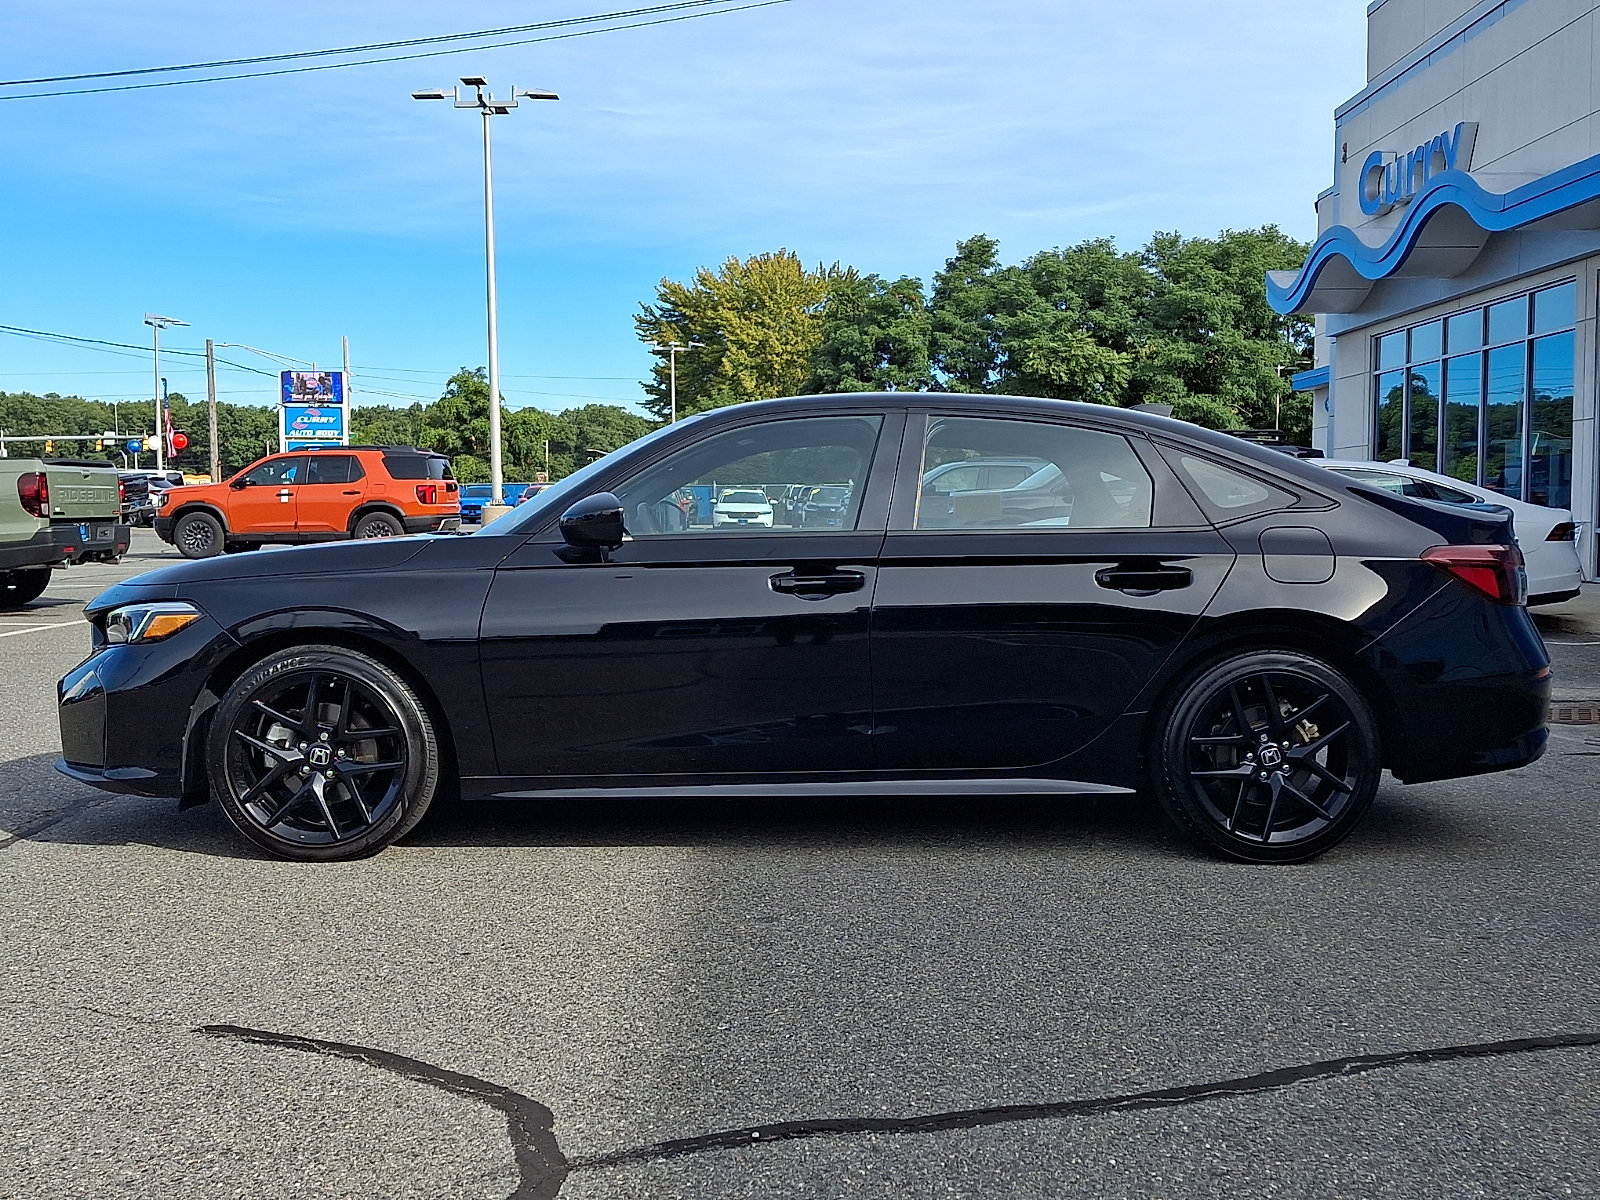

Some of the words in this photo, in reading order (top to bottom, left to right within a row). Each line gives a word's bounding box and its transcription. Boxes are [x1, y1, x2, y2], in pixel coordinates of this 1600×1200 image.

[1359, 121, 1479, 216] Curry
[296, 416, 336, 424] CURRY
[58, 489, 115, 502] RIDGELINE
